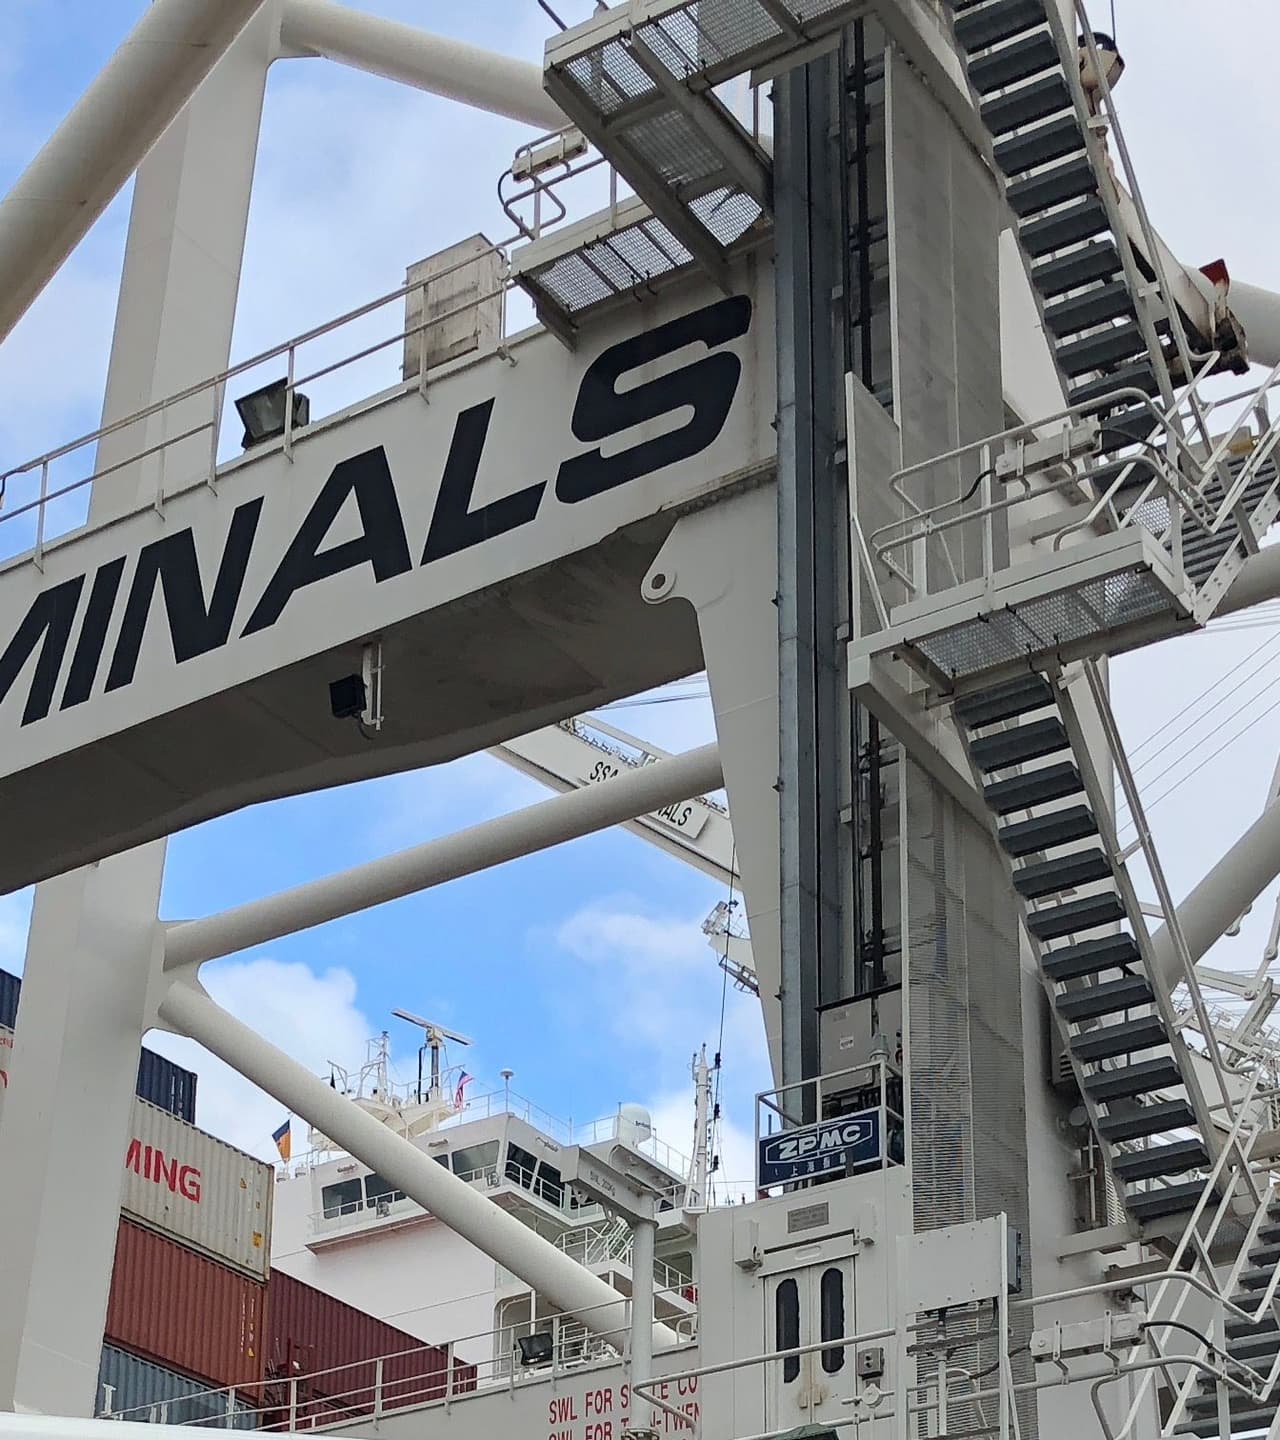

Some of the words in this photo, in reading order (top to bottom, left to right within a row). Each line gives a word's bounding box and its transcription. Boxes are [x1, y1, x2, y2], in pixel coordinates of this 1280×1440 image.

[779, 1125, 861, 1160] ZPMC
[549, 1397, 578, 1424] SWL
[585, 1388, 612, 1417] FOR
